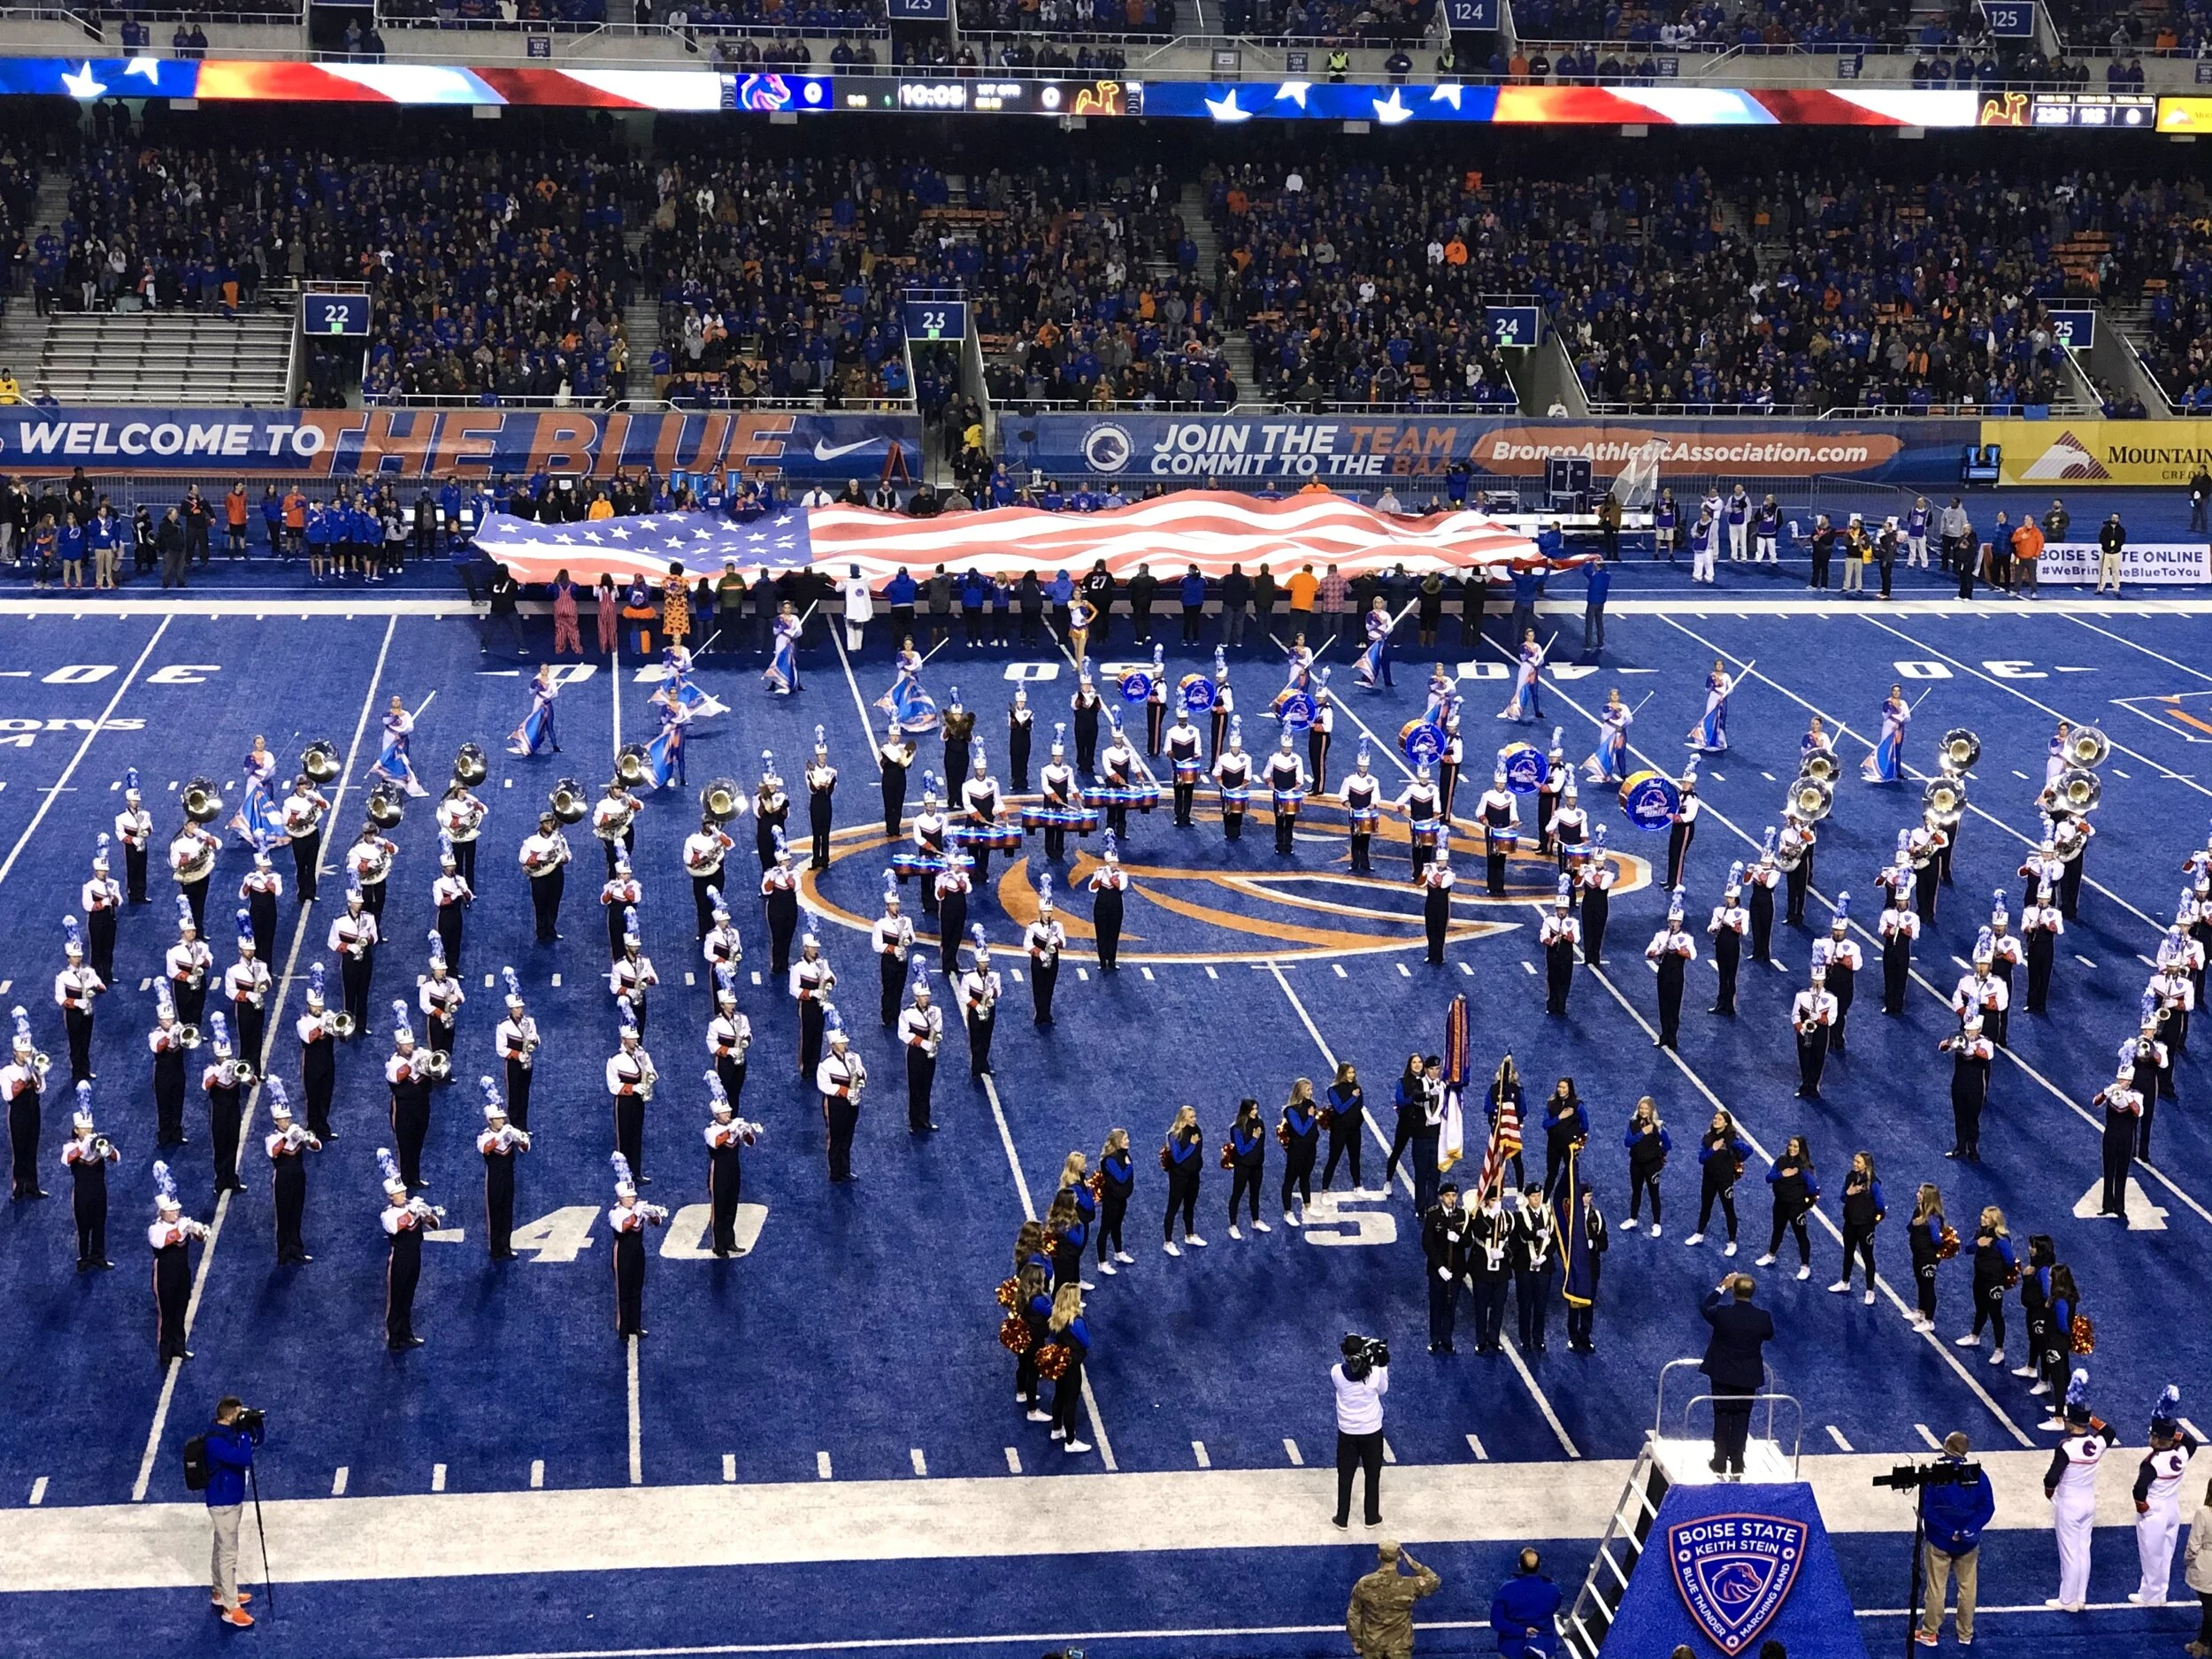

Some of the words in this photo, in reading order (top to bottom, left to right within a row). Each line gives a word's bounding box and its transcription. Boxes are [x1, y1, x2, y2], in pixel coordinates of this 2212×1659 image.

[1455, 3, 1483, 19] 124
[1991, 11, 2017, 27] 125
[804, 82, 823, 104] 0
[902, 84, 963, 106] 10:05
[1042, 87, 1060, 107] 0
[325, 304, 349, 322] 22
[922, 311, 945, 329] 23
[1495, 319, 1518, 334] 24
[2054, 320, 2073, 337] 25
[19, 422, 253, 456] WELCOME
[266, 424, 326, 457] TO
[301, 411, 506, 480] THE
[522, 411, 796, 480] BLUE
[1153, 425, 1251, 454] JOIN
[1261, 426, 1340, 454] THE
[1349, 426, 1457, 455] TEAM
[1492, 442, 1868, 463] BroncoAthleticAssociation.com
[1150, 453, 1272, 475] COMMIT
[1279, 454, 1318, 475] TO
[1327, 455, 1386, 476] THE
[2038, 549, 2085, 562] BOISE
[2091, 549, 2139, 563] STE
[2143, 550, 2203, 564] ONLINE
[1091, 575, 1108, 589] 27
[1678, 1523, 1736, 1546] BOISE
[1741, 1523, 1798, 1543] STATE
[1695, 1540, 1736, 1556] KEITH
[1740, 1540, 1779, 1555] STEIN
[1683, 1566, 1699, 1594] BLUE
[1694, 1594, 1726, 1638] THUNDER
[1740, 1592, 1778, 1637] MARCHING
[1773, 1563, 1791, 1591] BAND
